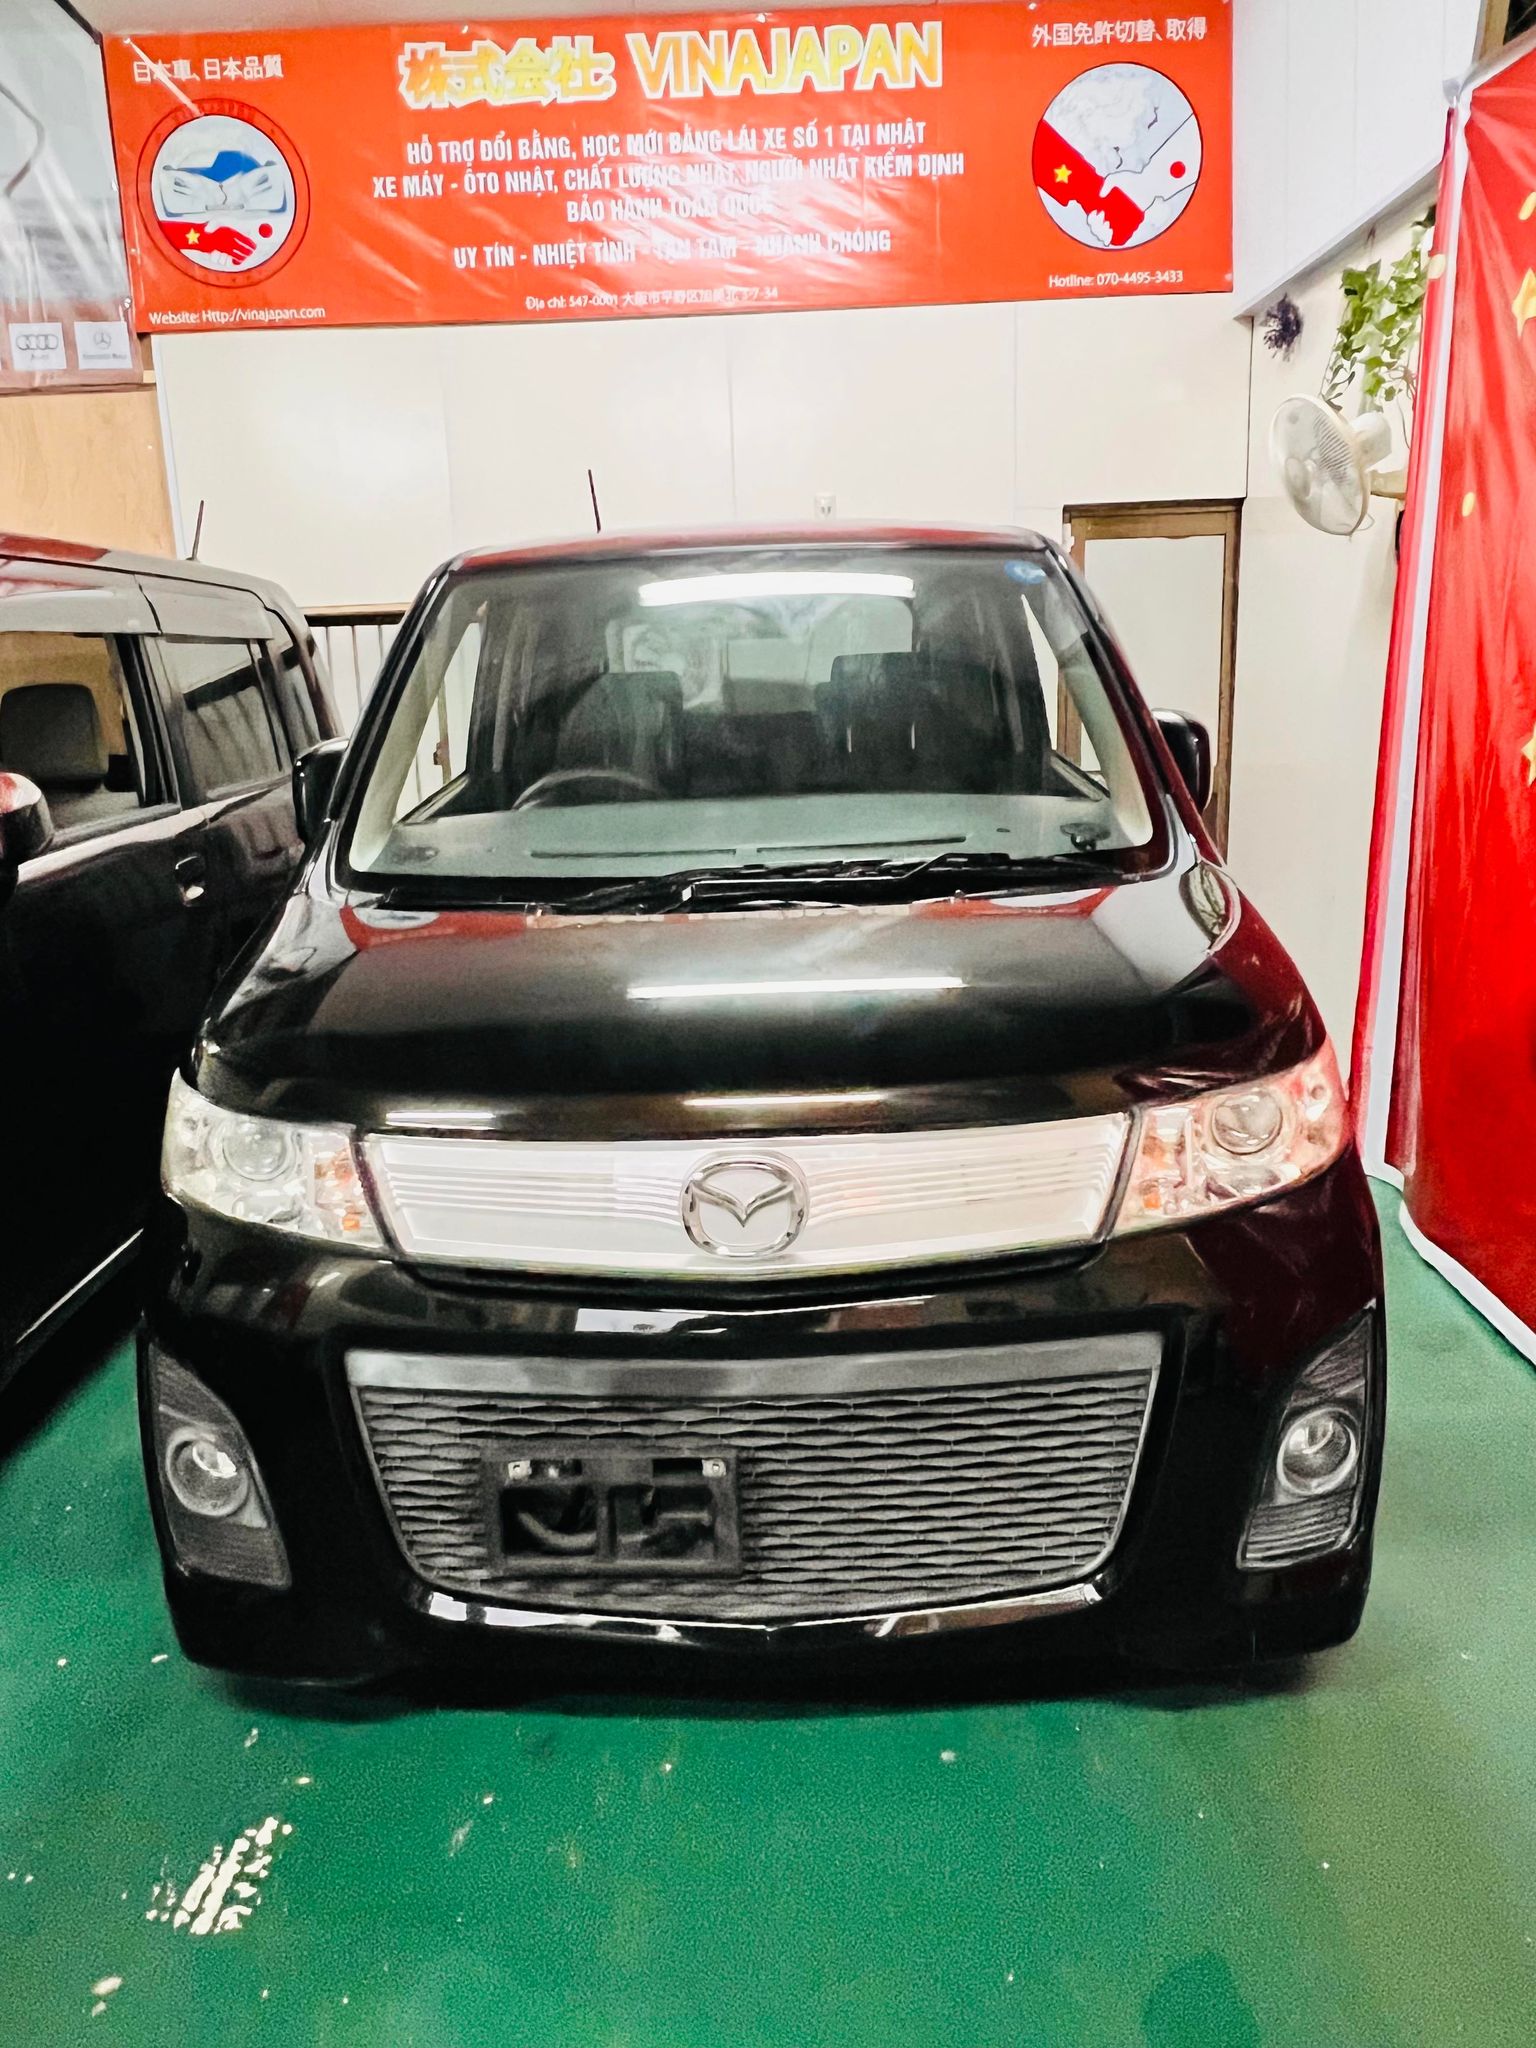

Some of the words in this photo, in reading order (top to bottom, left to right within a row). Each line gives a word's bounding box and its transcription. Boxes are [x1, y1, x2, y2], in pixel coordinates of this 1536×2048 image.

[399, 37, 616, 108] 株式会社
[625, 22, 943, 98] VINAJAPAN
[407, 134, 433, 164] HỖ
[438, 138, 474, 167] TRỢ
[480, 130, 512, 162] ĐỔI
[582, 135, 620, 159] HỌC
[627, 129, 663, 156] MỚI
[727, 125, 756, 151] LÁI
[763, 127, 786, 149] XE
[793, 118, 818, 148] SỐ
[824, 125, 833, 147] 1
[841, 124, 870, 151] TẠI
[876, 117, 926, 149] NHẬT
[373, 176, 398, 199] XE
[402, 170, 444, 199] MÁY
[564, 158, 612, 191] CHẤT
[809, 153, 858, 183] NHẬT
[865, 147, 912, 178] KIỂM
[918, 153, 964, 181] ĐỊNH
[567, 194, 604, 223] BẢO
[454, 247, 477, 268] UY
[483, 242, 514, 267] TÍN
[533, 239, 587, 269] NHIỆT
[591, 236, 636, 264] TÌNH
[828, 226, 891, 254] CHÓNG
[1096, 270, 1184, 286] 070-4495-3433
[149, 311, 199, 325] Website:
